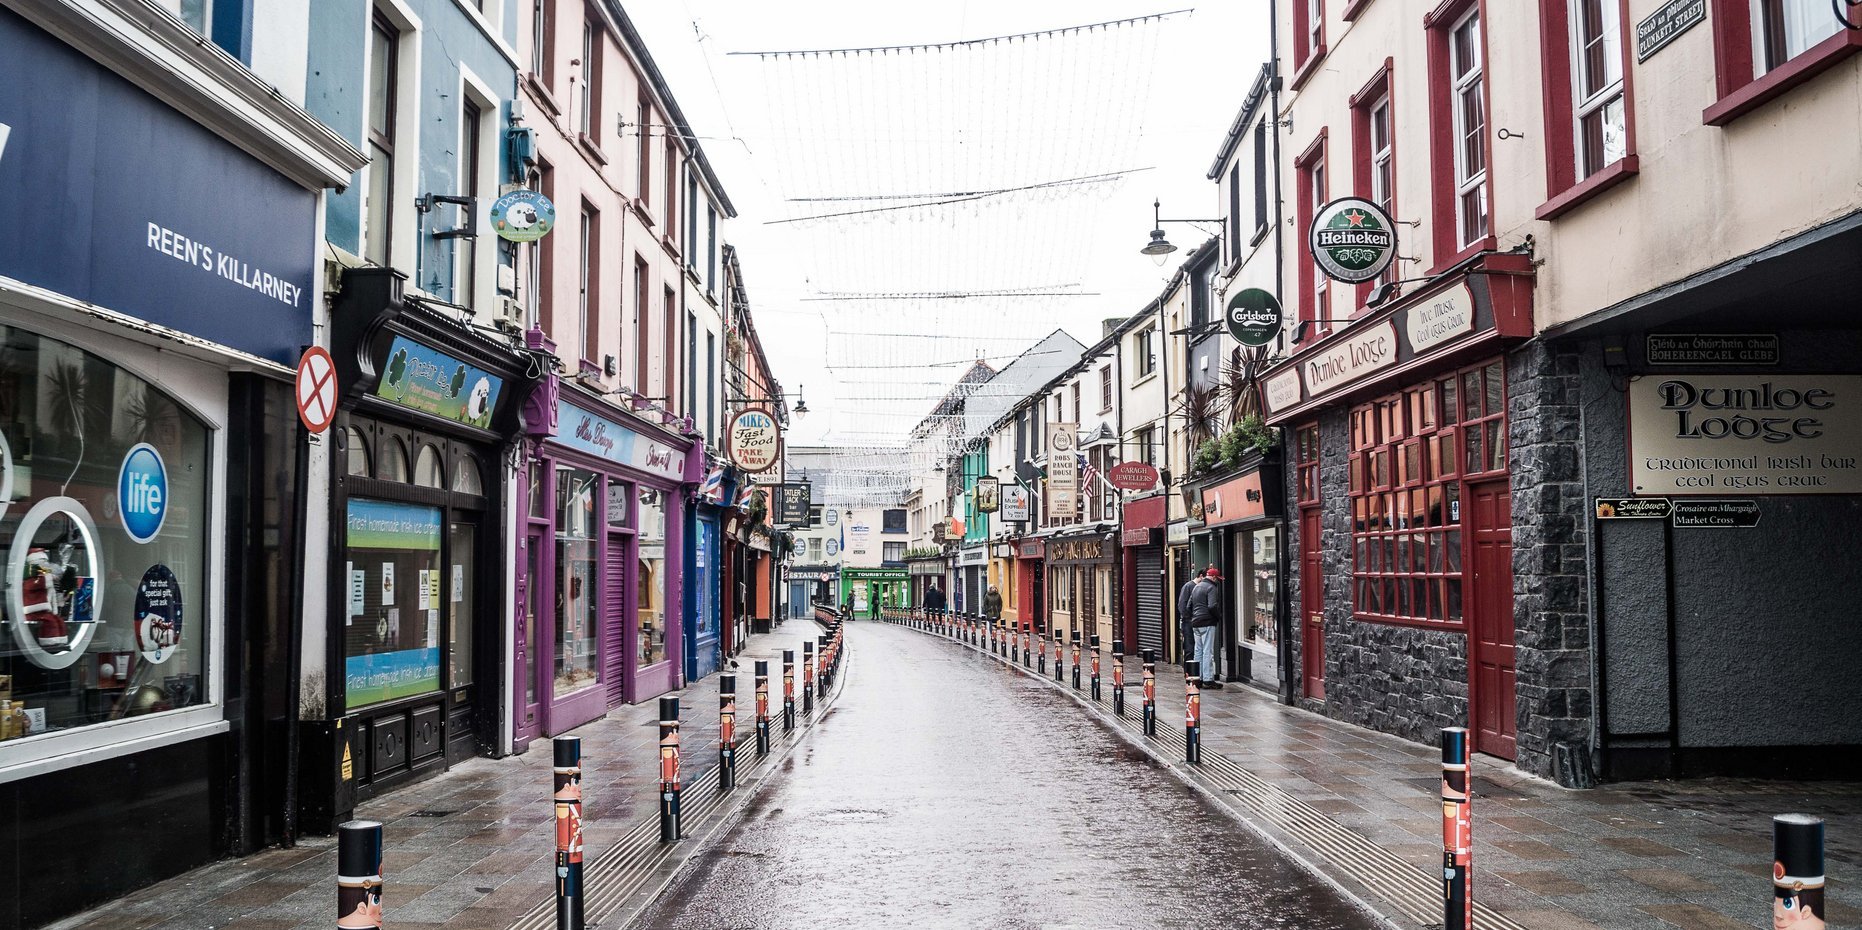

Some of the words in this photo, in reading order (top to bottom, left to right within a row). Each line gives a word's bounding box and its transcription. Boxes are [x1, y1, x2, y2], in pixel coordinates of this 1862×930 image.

[1640, 21, 1673, 53] PLUNKETT
[1675, 3, 1701, 28] STREET
[1320, 231, 1389, 246] Heineken
[147, 221, 213, 272] REEN'S
[217, 252, 302, 308] KILLARNEY
[1231, 307, 1278, 327] Carlsberg
[1310, 354, 1346, 386] Dunloe
[1348, 336, 1388, 369] Lodge
[1650, 350, 1735, 360] BOHEREENCAEL
[1739, 350, 1775, 360] GLEBE
[1658, 380, 1836, 410] Dunloe
[739, 414, 771, 427] MIKE'S
[1675, 410, 1824, 444] Lodge
[735, 428, 764, 439] Fast
[740, 436, 773, 448] Food
[737, 448, 763, 457] TAKE
[1120, 466, 1147, 474] CARAGH
[127, 472, 162, 515] life
[1617, 500, 1666, 512] Sunflower
[1675, 504, 1706, 512] Crosaire
[1676, 516, 1707, 524] Market
[1709, 516, 1734, 524] Cross
[157, 579, 168, 587] that
[145, 588, 160, 598] special
[149, 598, 159, 607] just
[159, 598, 168, 606] ask
